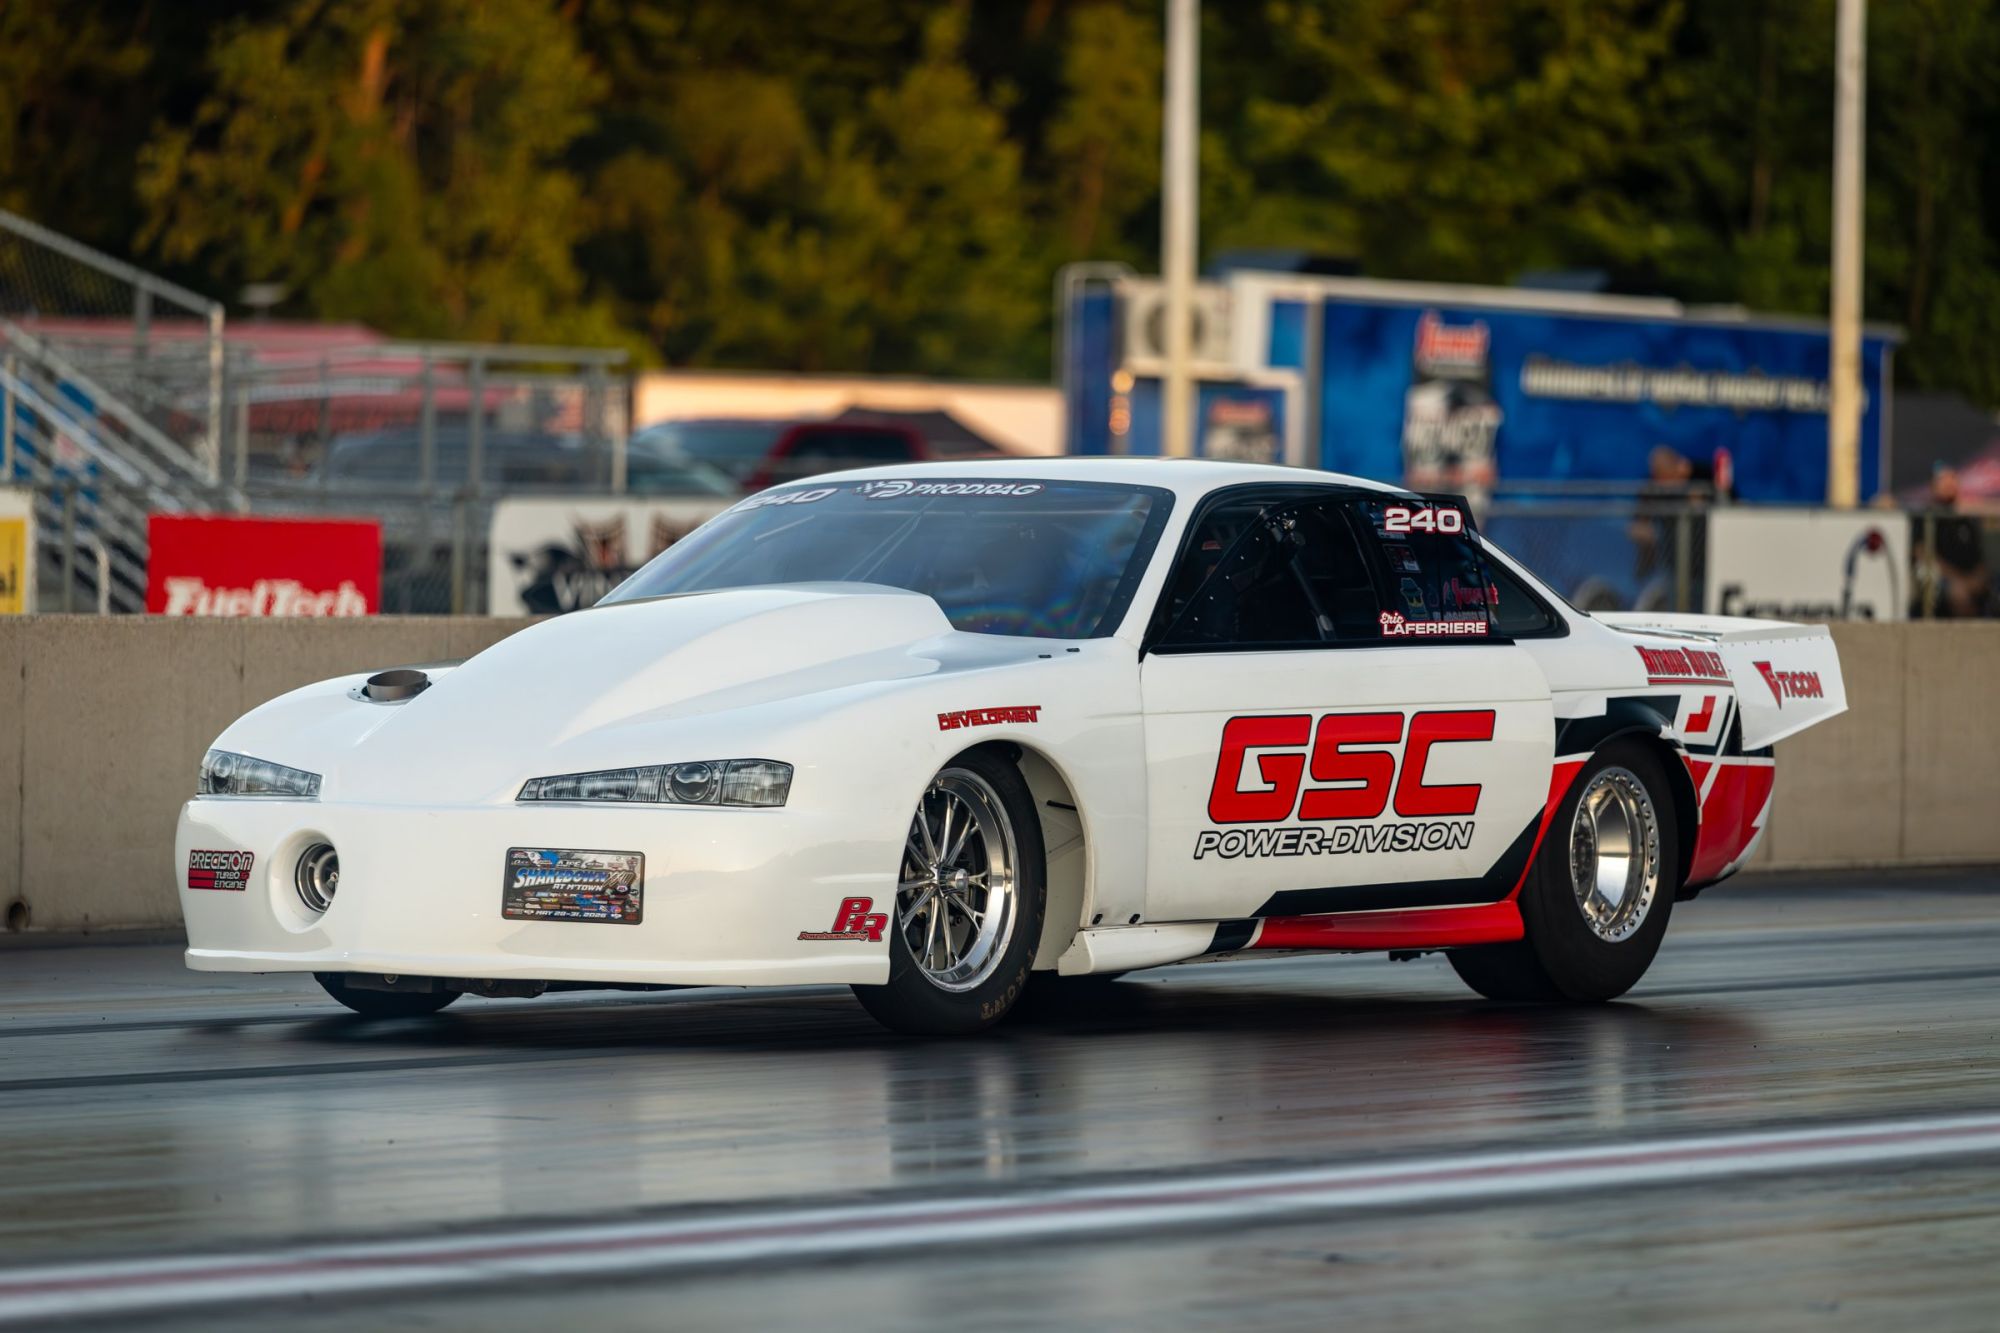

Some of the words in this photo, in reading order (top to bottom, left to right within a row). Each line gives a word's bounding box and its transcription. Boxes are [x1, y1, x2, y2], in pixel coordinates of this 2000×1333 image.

[906, 483, 1042, 497] PRODRAG
[1385, 508, 1462, 533] 240
[164, 576, 367, 616] FuelTech
[1380, 611, 1405, 625] Eric
[1383, 621, 1487, 636] LAFERRIERE
[937, 705, 1042, 731] DEVELOPMENT
[1207, 709, 1496, 824] GSC
[1193, 821, 1475, 859] POWER-DIVISION
[215, 871, 240, 880] TURBO
[513, 867, 609, 889] SHAKEDOWN
